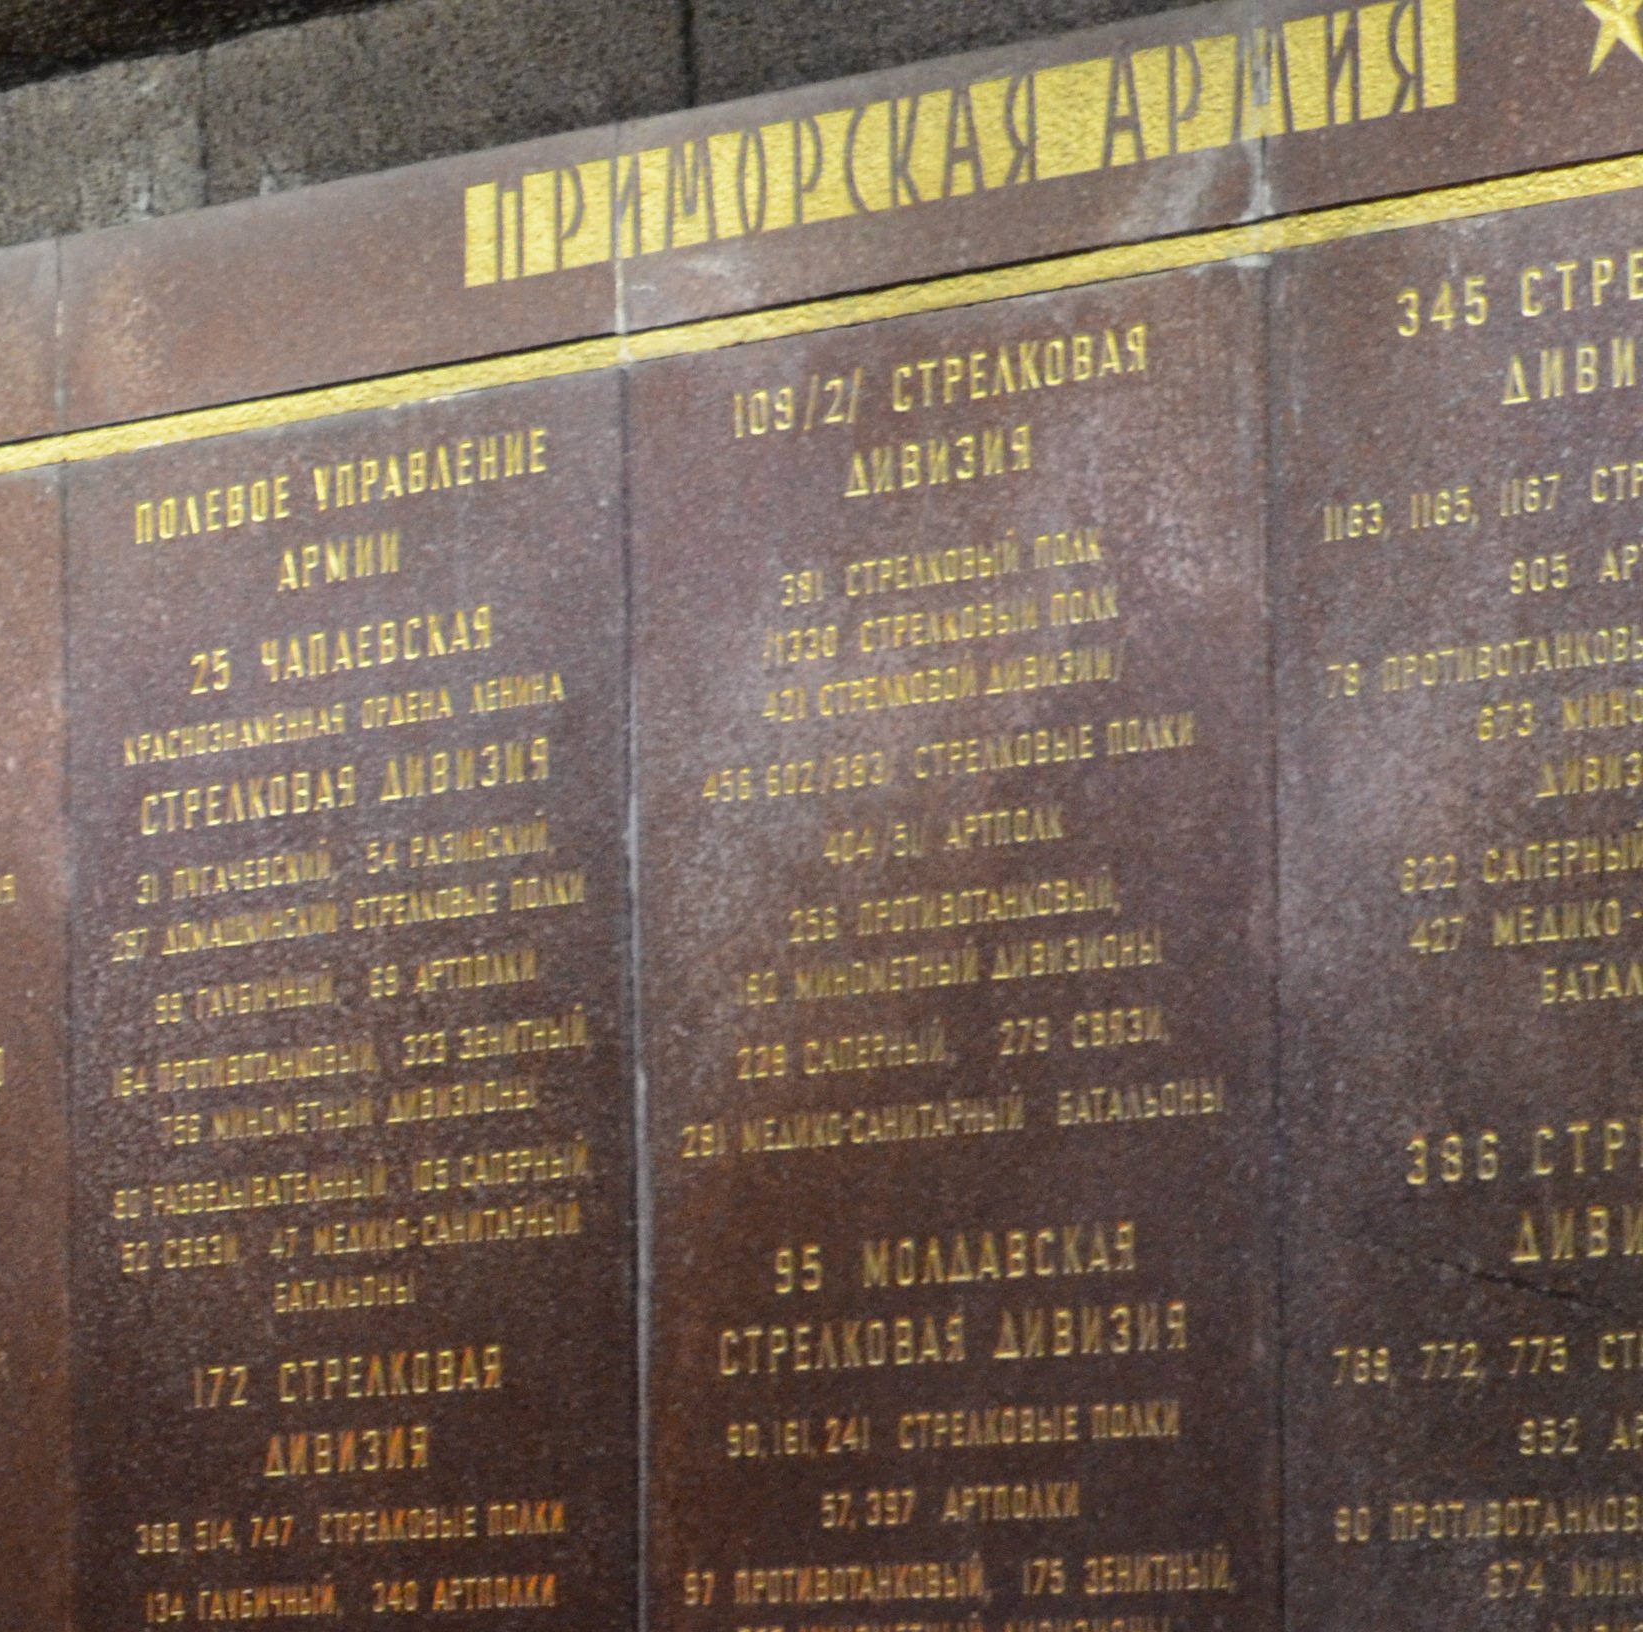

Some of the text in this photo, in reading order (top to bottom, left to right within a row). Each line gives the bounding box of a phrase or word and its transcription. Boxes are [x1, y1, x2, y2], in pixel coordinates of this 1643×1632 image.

[1396, 276, 1489, 337] 345
[733, 322, 1150, 440] 109/2/ СТРЕЛКОВАЯ
[134, 427, 548, 544] ПОЛЕВОЕ УПРАВЛЕНИЕ
[843, 422, 1033, 498] ДИВИЗИЯ
[277, 528, 401, 592] АРМИИ
[845, 528, 1104, 599] СТРЕЛКОВЫЙ ПОЛК
[1508, 554, 1570, 595] 905
[1051, 585, 1120, 624] ПОЛК
[189, 605, 494, 695] 25 ЧАПАЕВСКАЯ
[817, 650, 976, 718] СТРЕЛКОВОЙ
[122, 671, 565, 768] КРАСНОЗНАМЕННАЯ ОРДЕНА ЛЕНИНА
[914, 712, 1197, 780] СТРЕЛКОВЫЕ ПОЛКИ
[140, 736, 551, 837] СТРЕЛКОВАЯ ДИВИЗИЯ
[351, 869, 587, 931] СТРЕЛКОВЫЕ ПОЛКИ
[794, 928, 1164, 1001] МИНОМЕТНЫЙ ДИВИЗИОНЫ
[1409, 916, 1466, 954] 427
[387, 1077, 537, 1124] ДИВИЗИОНЫ
[741, 1078, 1226, 1152] МЕДИКО-САНИТАРНЫЙ БАТАЛЬОНЫ
[1404, 1133, 1499, 1186] 386
[774, 1220, 1137, 1294] 95 МОЛДАВСКАЯ
[274, 1272, 416, 1314] БАТАЛЬОНЫ
[717, 1300, 1189, 1376] СТРЕЛКОВАЯ ДИВИЗИЯ
[1508, 1335, 1569, 1375] 775
[191, 1343, 504, 1409] 172 СТРЕЛКОВАЯ
[263, 1424, 430, 1478] ДИВИЗИЯ
[897, 1400, 1181, 1450] СТРЕЛКОВЫЕ ПОЛКИ
[318, 1504, 477, 1545] СТРЕЛКОВЫЕ
[487, 1500, 566, 1537] ПОЛКИ
[943, 1480, 1081, 1522] АРТПОЛКИ
[433, 1574, 558, 1611] АРТПОЛКИ
